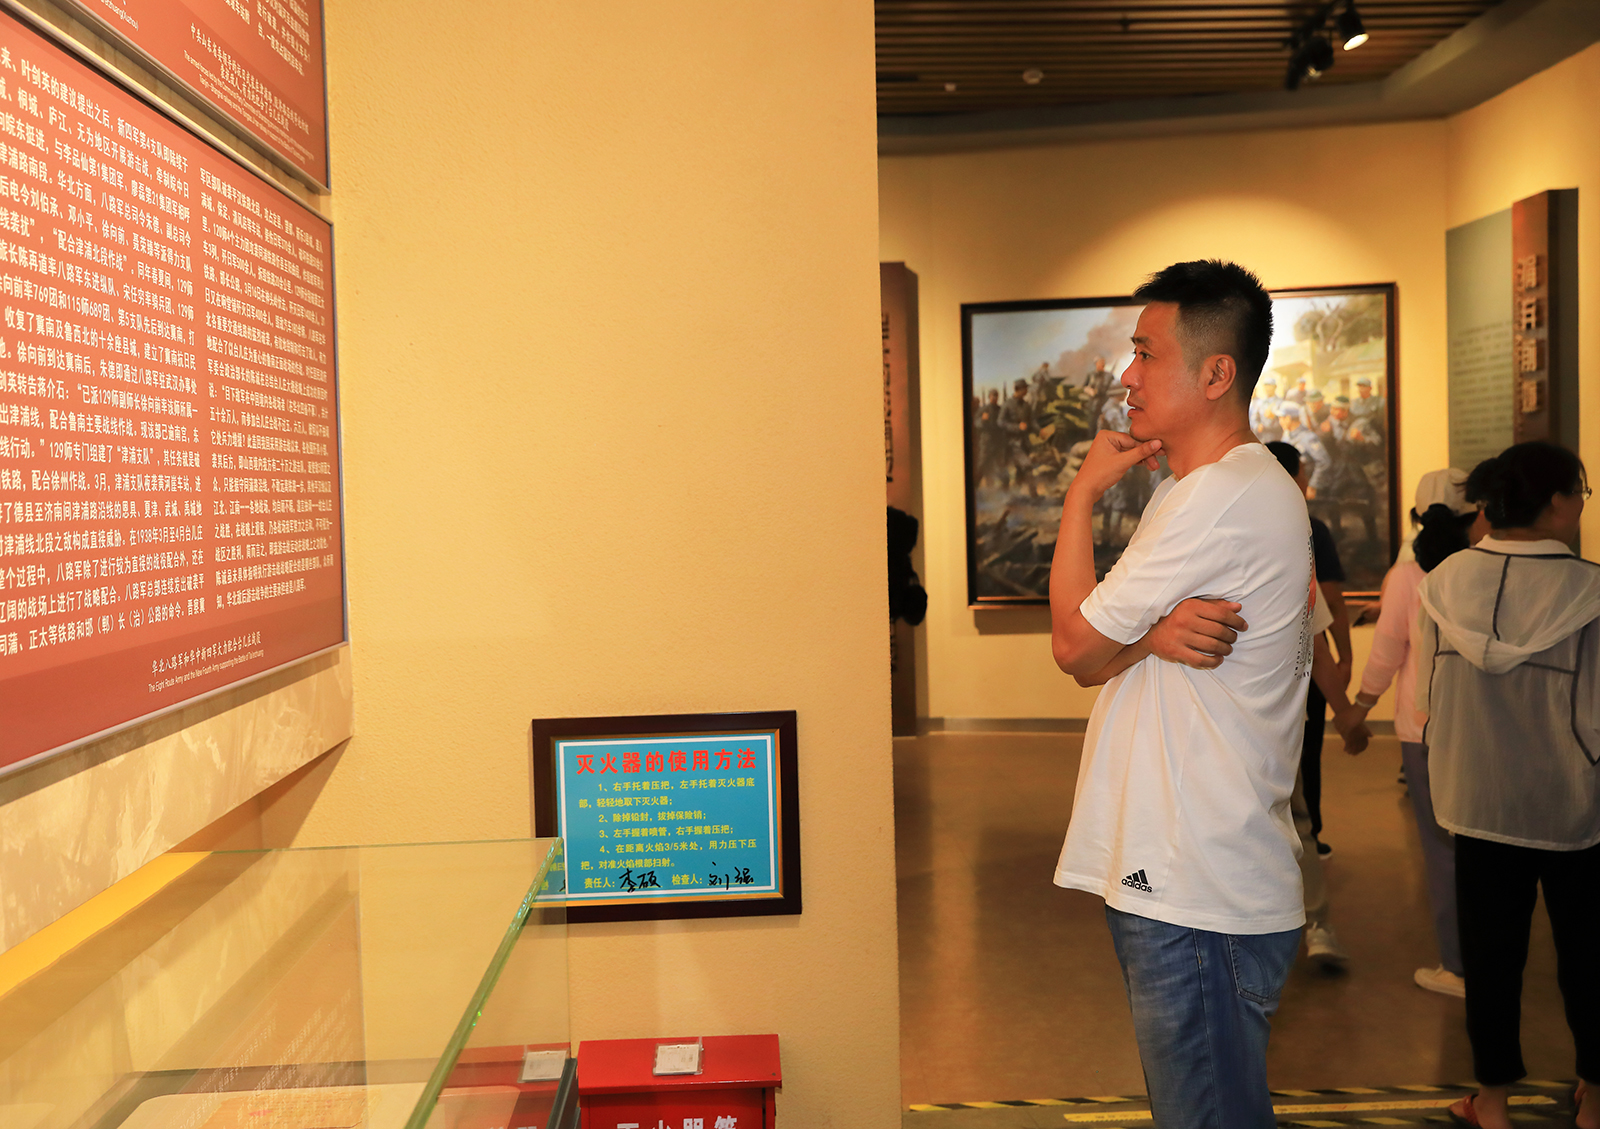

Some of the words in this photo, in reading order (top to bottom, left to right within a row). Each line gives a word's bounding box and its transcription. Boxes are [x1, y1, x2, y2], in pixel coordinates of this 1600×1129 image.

[0, 271, 194, 346] 向前率769团和115师689团、第5支队先后到达冀南，打
[0, 468, 200, 492] 铁路，配合徐州作战。3月，津浦支队夜袭黄河崖车站，进
[576, 748, 757, 775] 灭火器的使用方法
[1121, 878, 1153, 893] adidas
